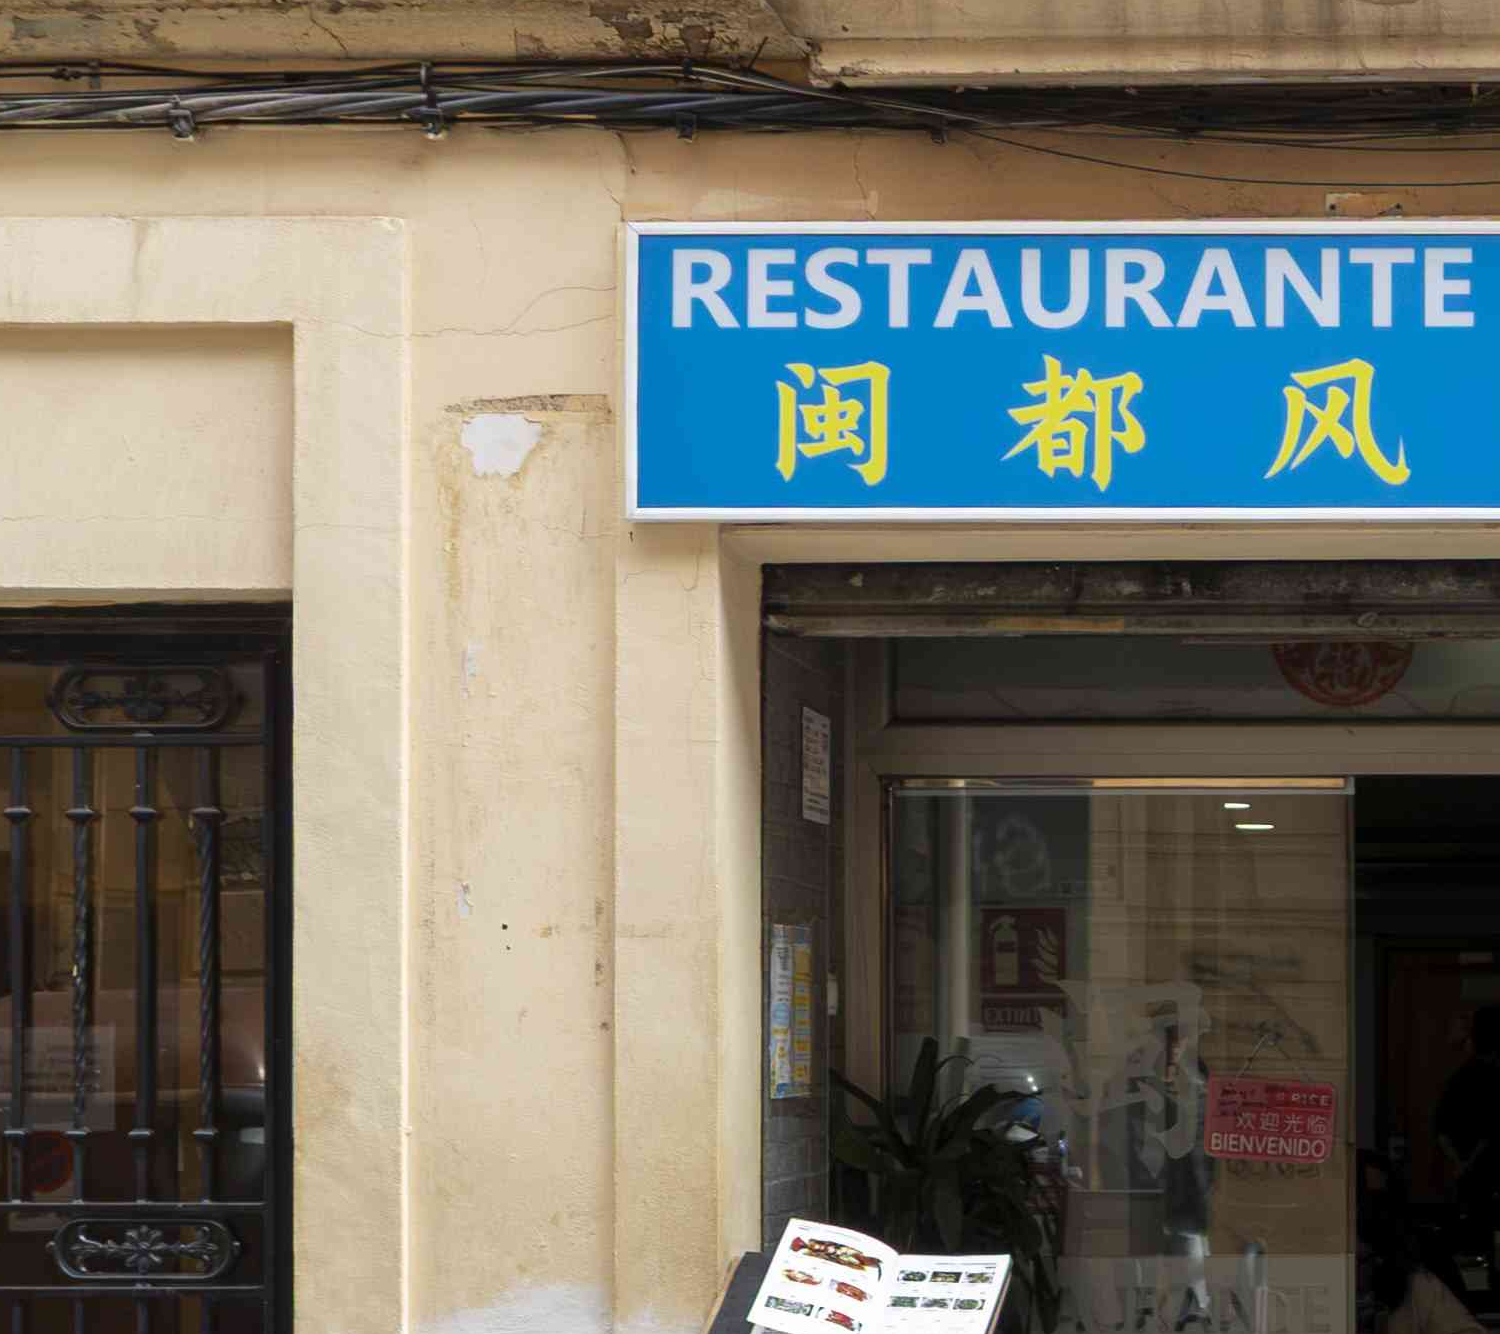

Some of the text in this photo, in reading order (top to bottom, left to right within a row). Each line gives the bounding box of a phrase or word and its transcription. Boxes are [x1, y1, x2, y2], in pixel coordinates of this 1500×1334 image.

[670, 245, 1476, 331] RESTAURANTE
[1235, 1111, 1327, 1135] 欢迎光临
[1210, 1132, 1326, 1158] BIENVENIDO
